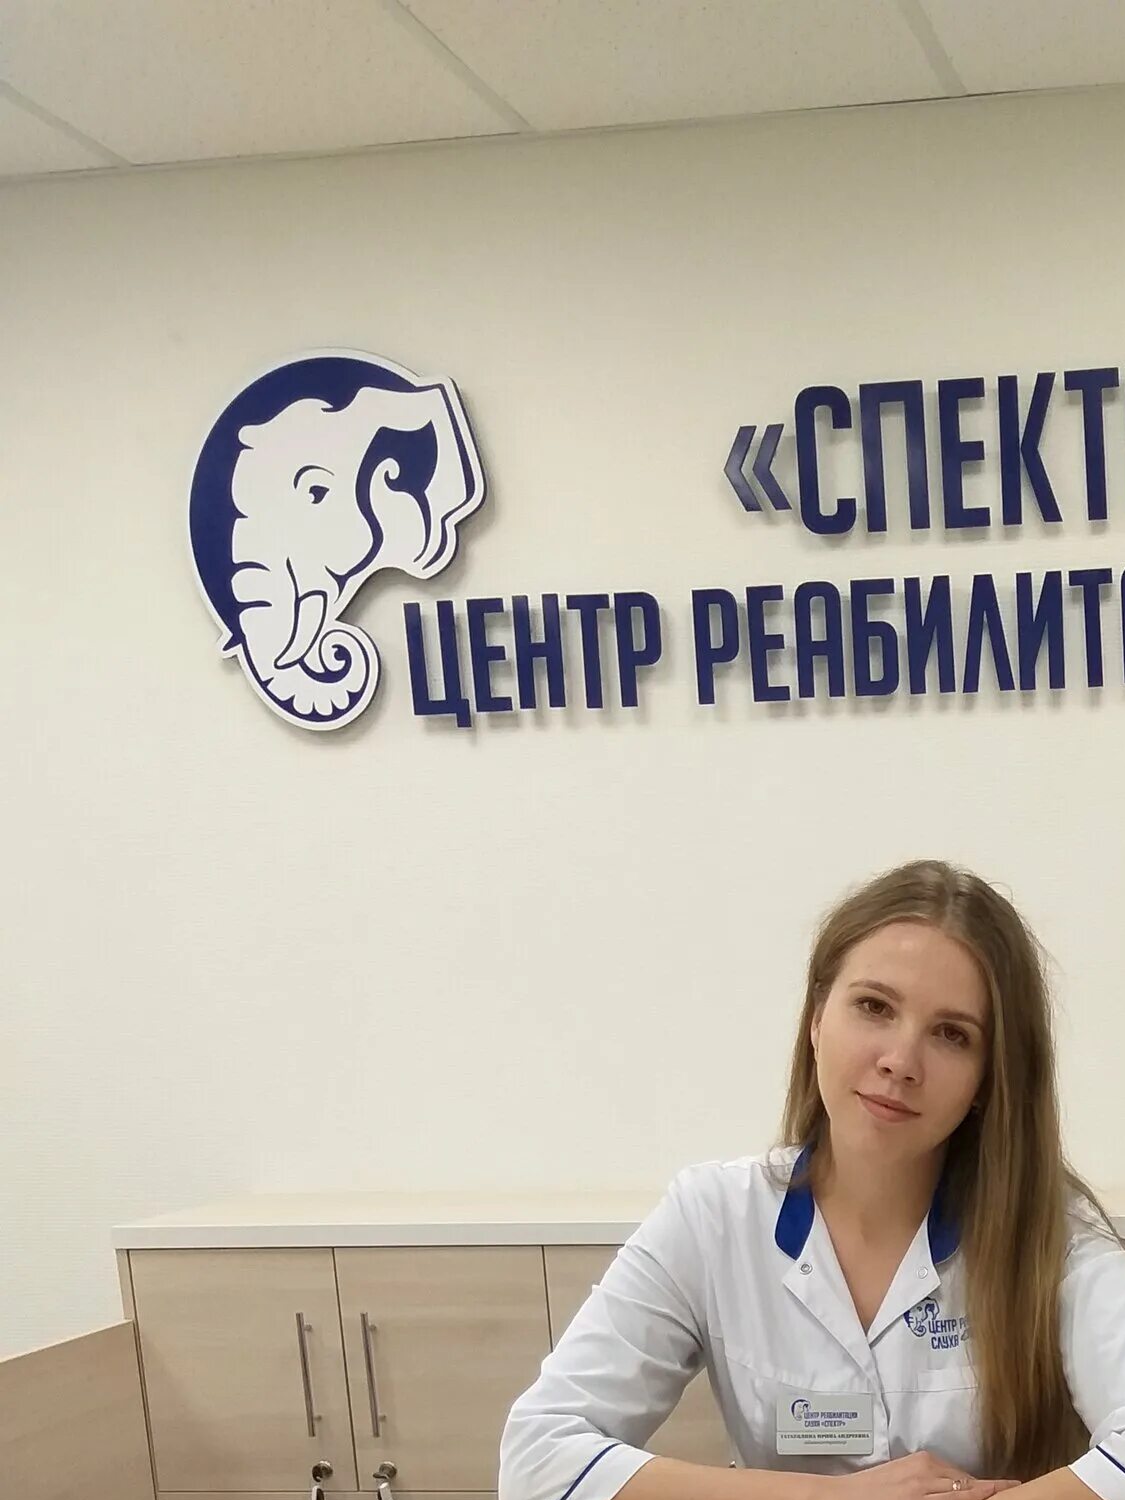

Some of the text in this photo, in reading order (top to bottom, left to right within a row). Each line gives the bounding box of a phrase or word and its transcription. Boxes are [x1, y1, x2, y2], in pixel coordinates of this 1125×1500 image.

[405, 592, 662, 728] ЦЕНТР
[928, 1318, 957, 1334] ЦЕНТР
[931, 1334, 960, 1350] СЛУХА
